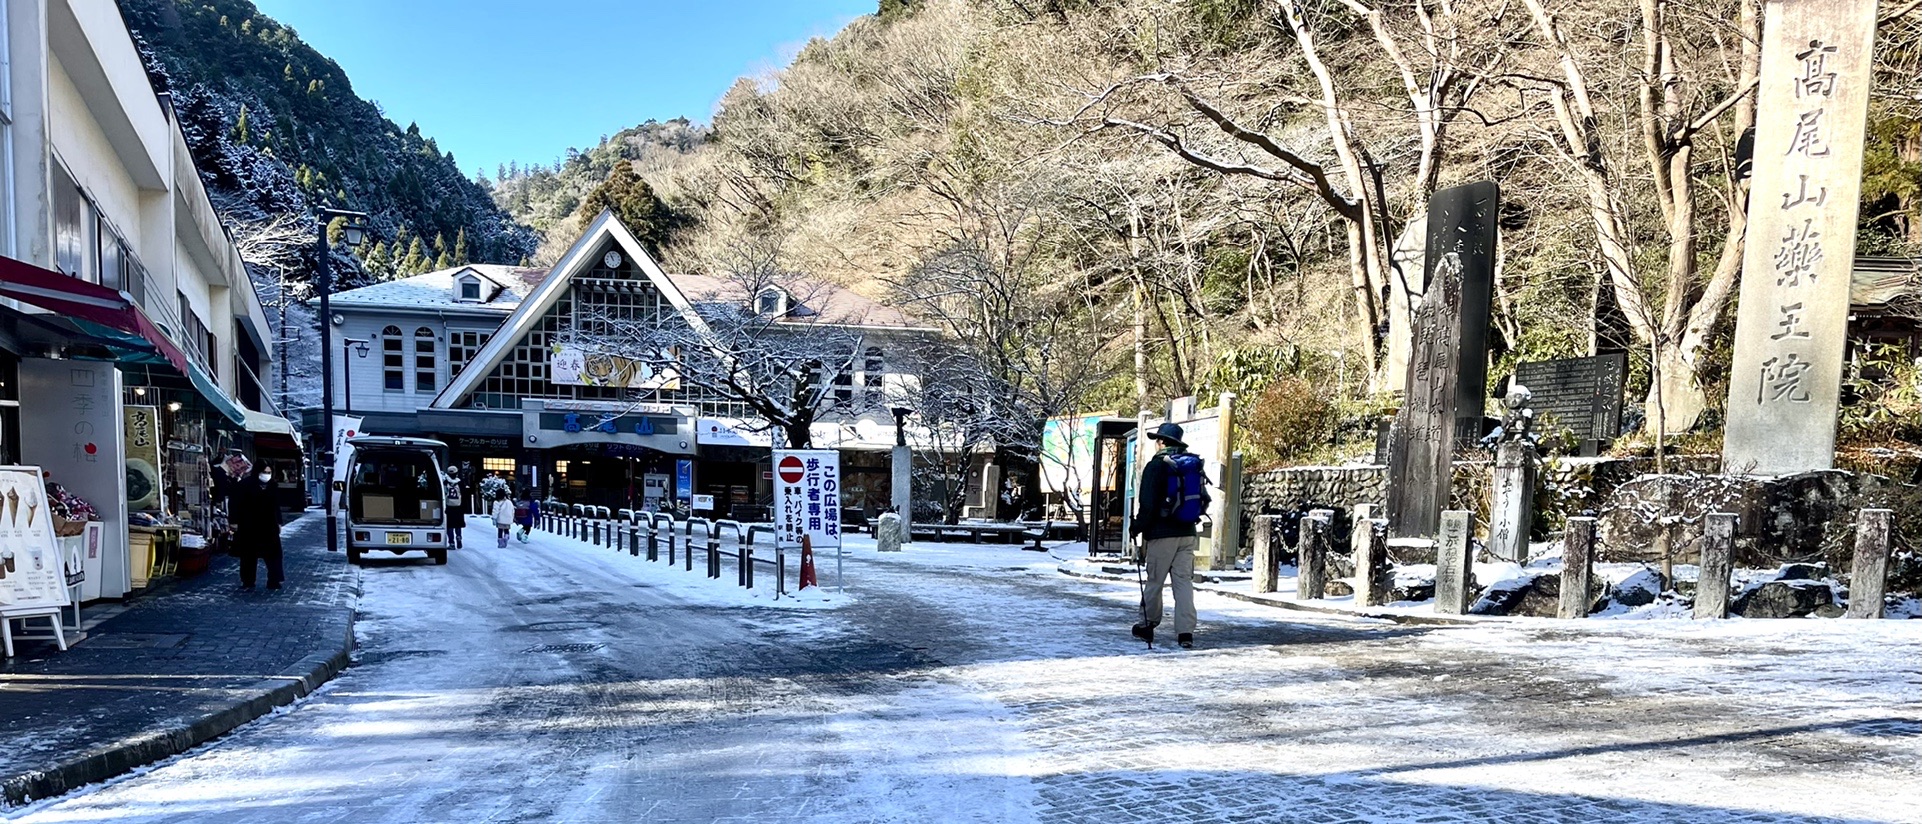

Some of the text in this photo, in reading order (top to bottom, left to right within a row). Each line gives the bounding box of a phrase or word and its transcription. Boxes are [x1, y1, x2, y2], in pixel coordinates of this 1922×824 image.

[557, 359, 580, 371] 迎春
[784, 486, 794, 542] 乗入れを禁止
[793, 486, 804, 544] 車、バイク等の
[806, 457, 821, 531] 歩行者専用
[823, 465, 838, 540] この広場は、
